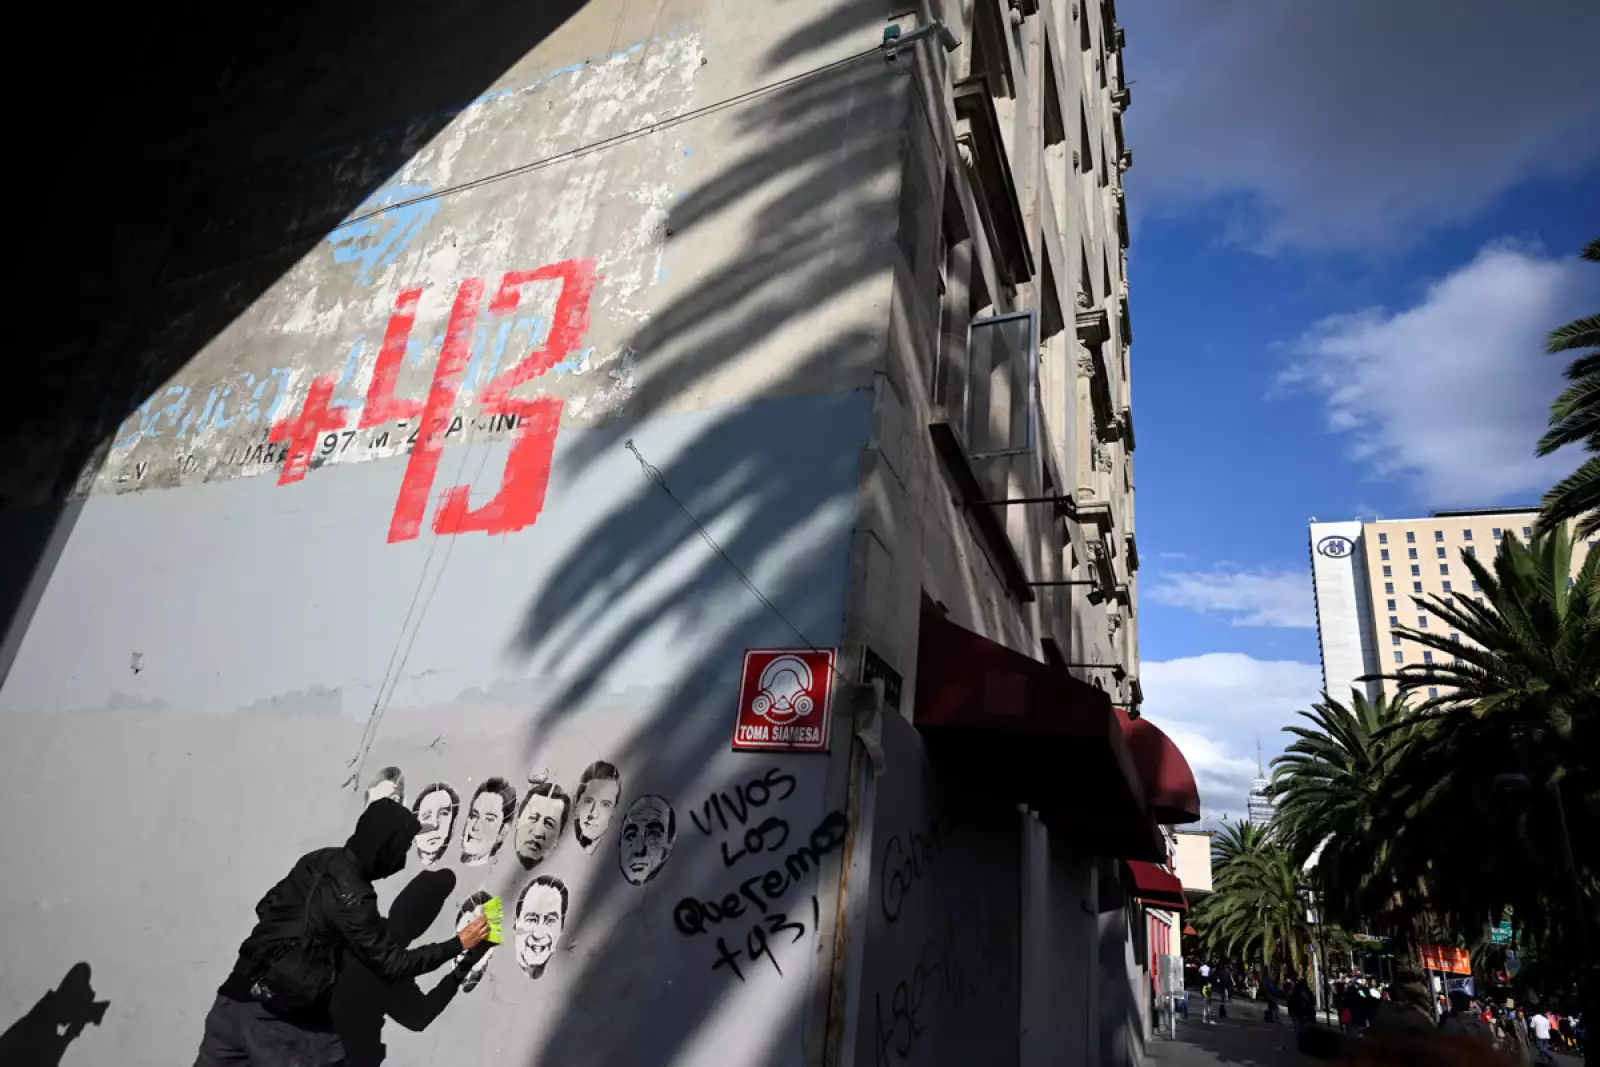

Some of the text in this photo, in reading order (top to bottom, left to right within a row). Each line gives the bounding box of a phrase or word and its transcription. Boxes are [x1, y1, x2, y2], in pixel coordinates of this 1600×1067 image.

[320, 430, 357, 456] 97
[740, 725, 819, 743] TOMA SIAMESA
[690, 767, 796, 836] VIVOS
